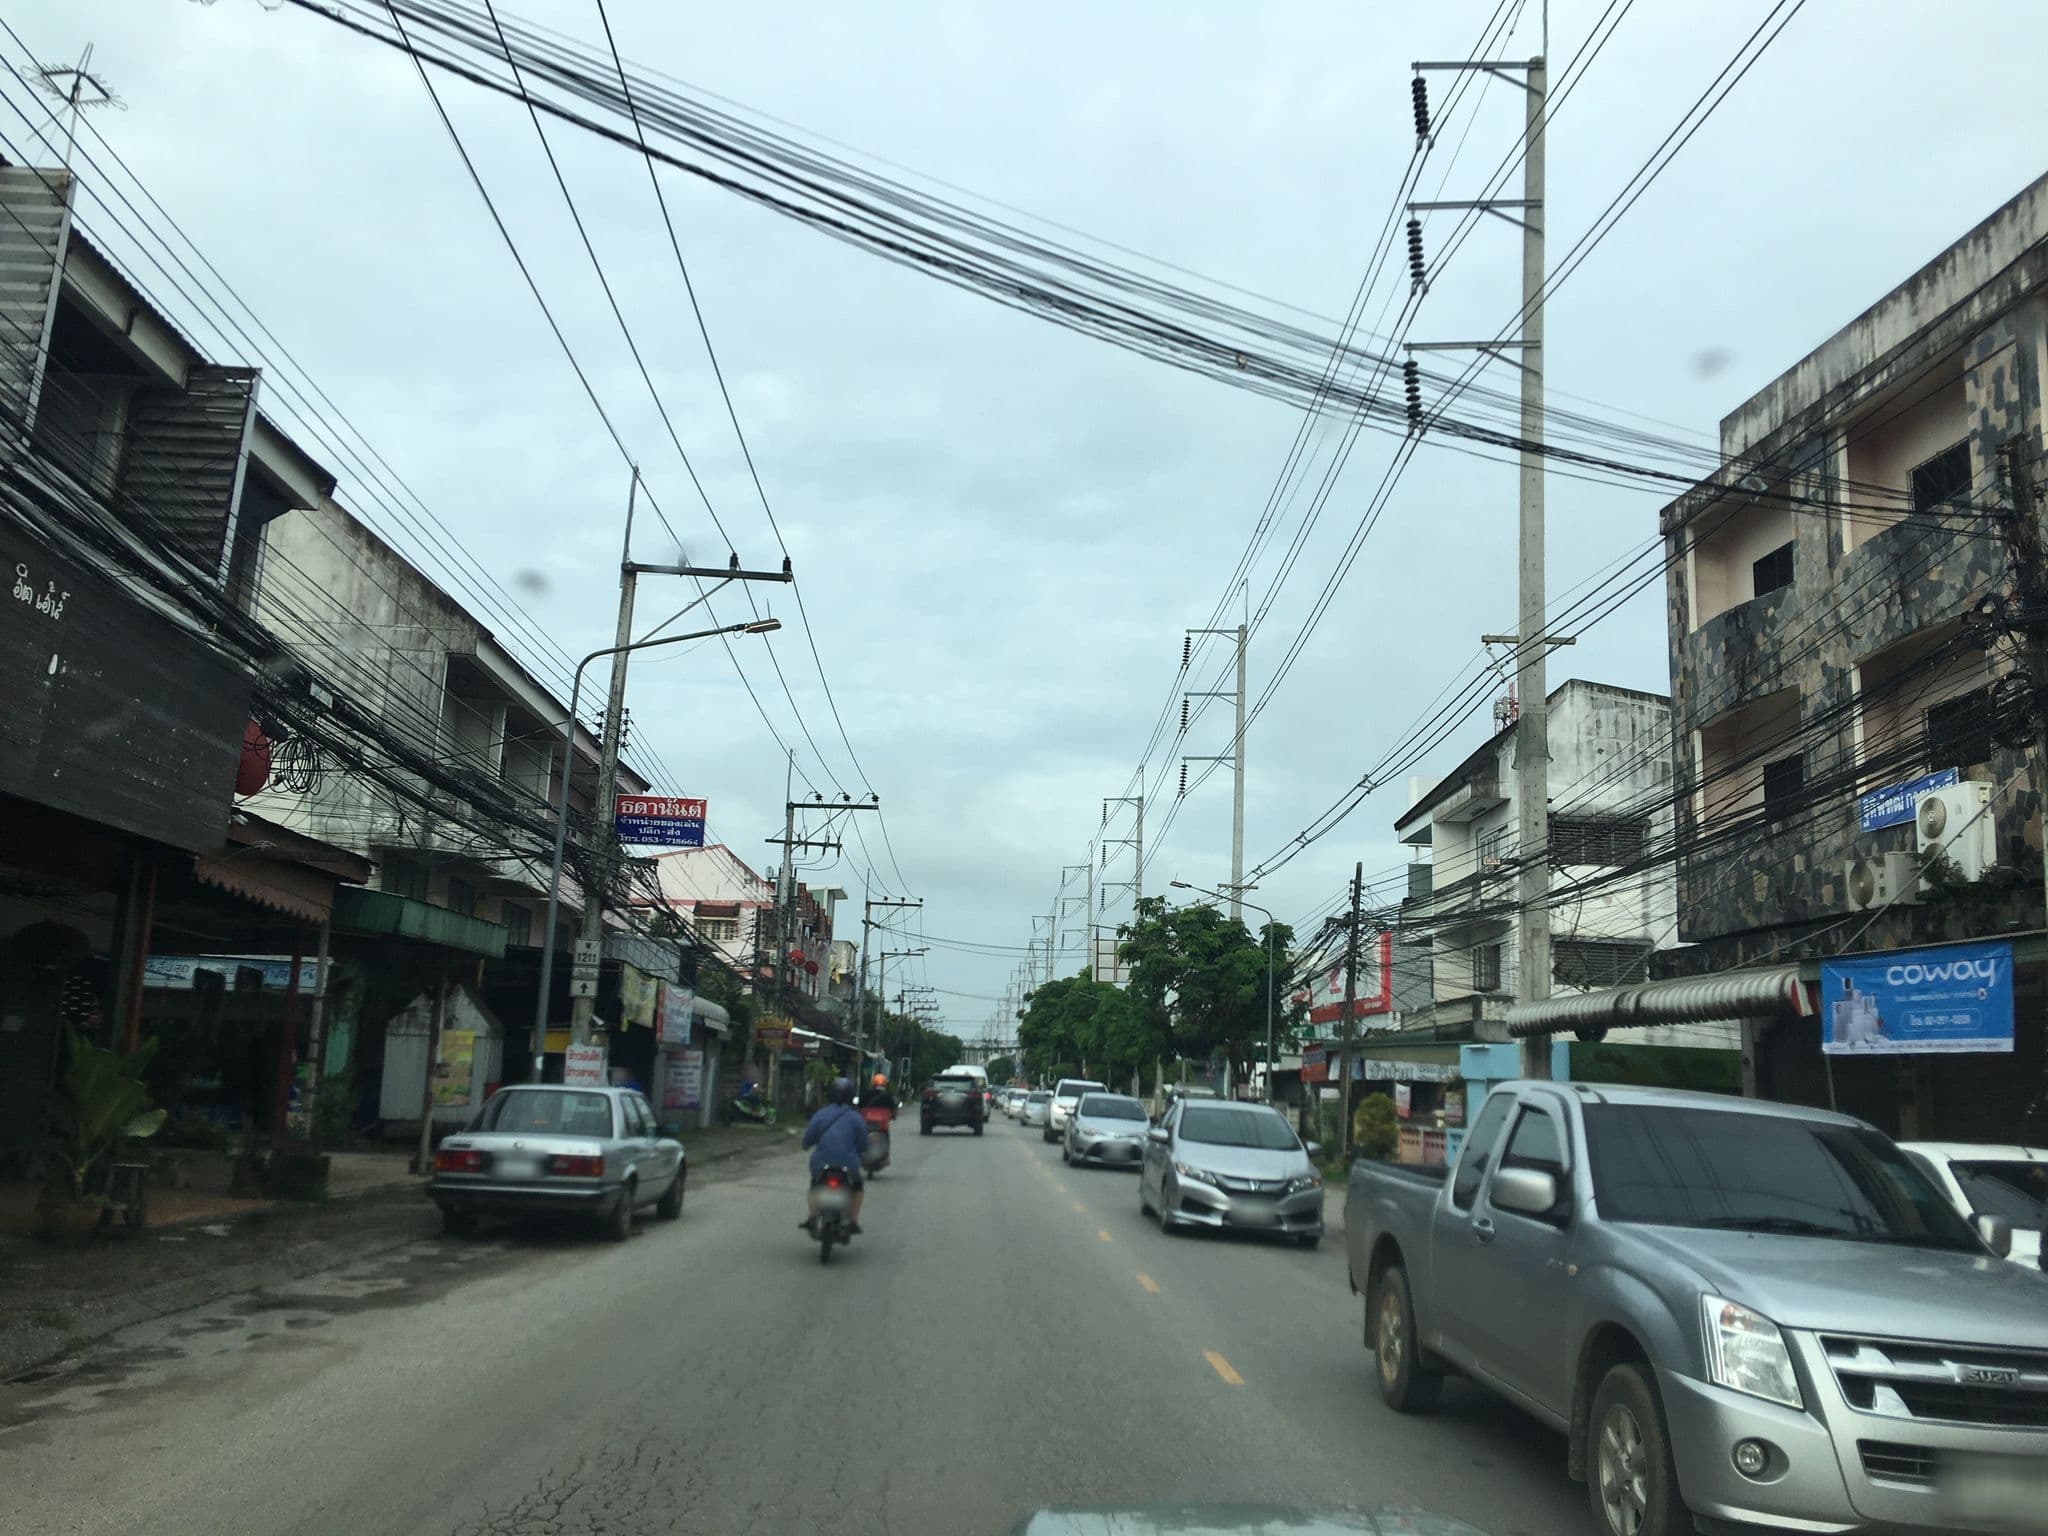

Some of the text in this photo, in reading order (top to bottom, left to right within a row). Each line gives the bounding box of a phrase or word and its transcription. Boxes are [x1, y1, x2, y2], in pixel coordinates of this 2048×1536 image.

[577, 952, 597, 963] 1211
[1886, 958, 1994, 988] coway
[1963, 1369, 2016, 1383] SUZU
